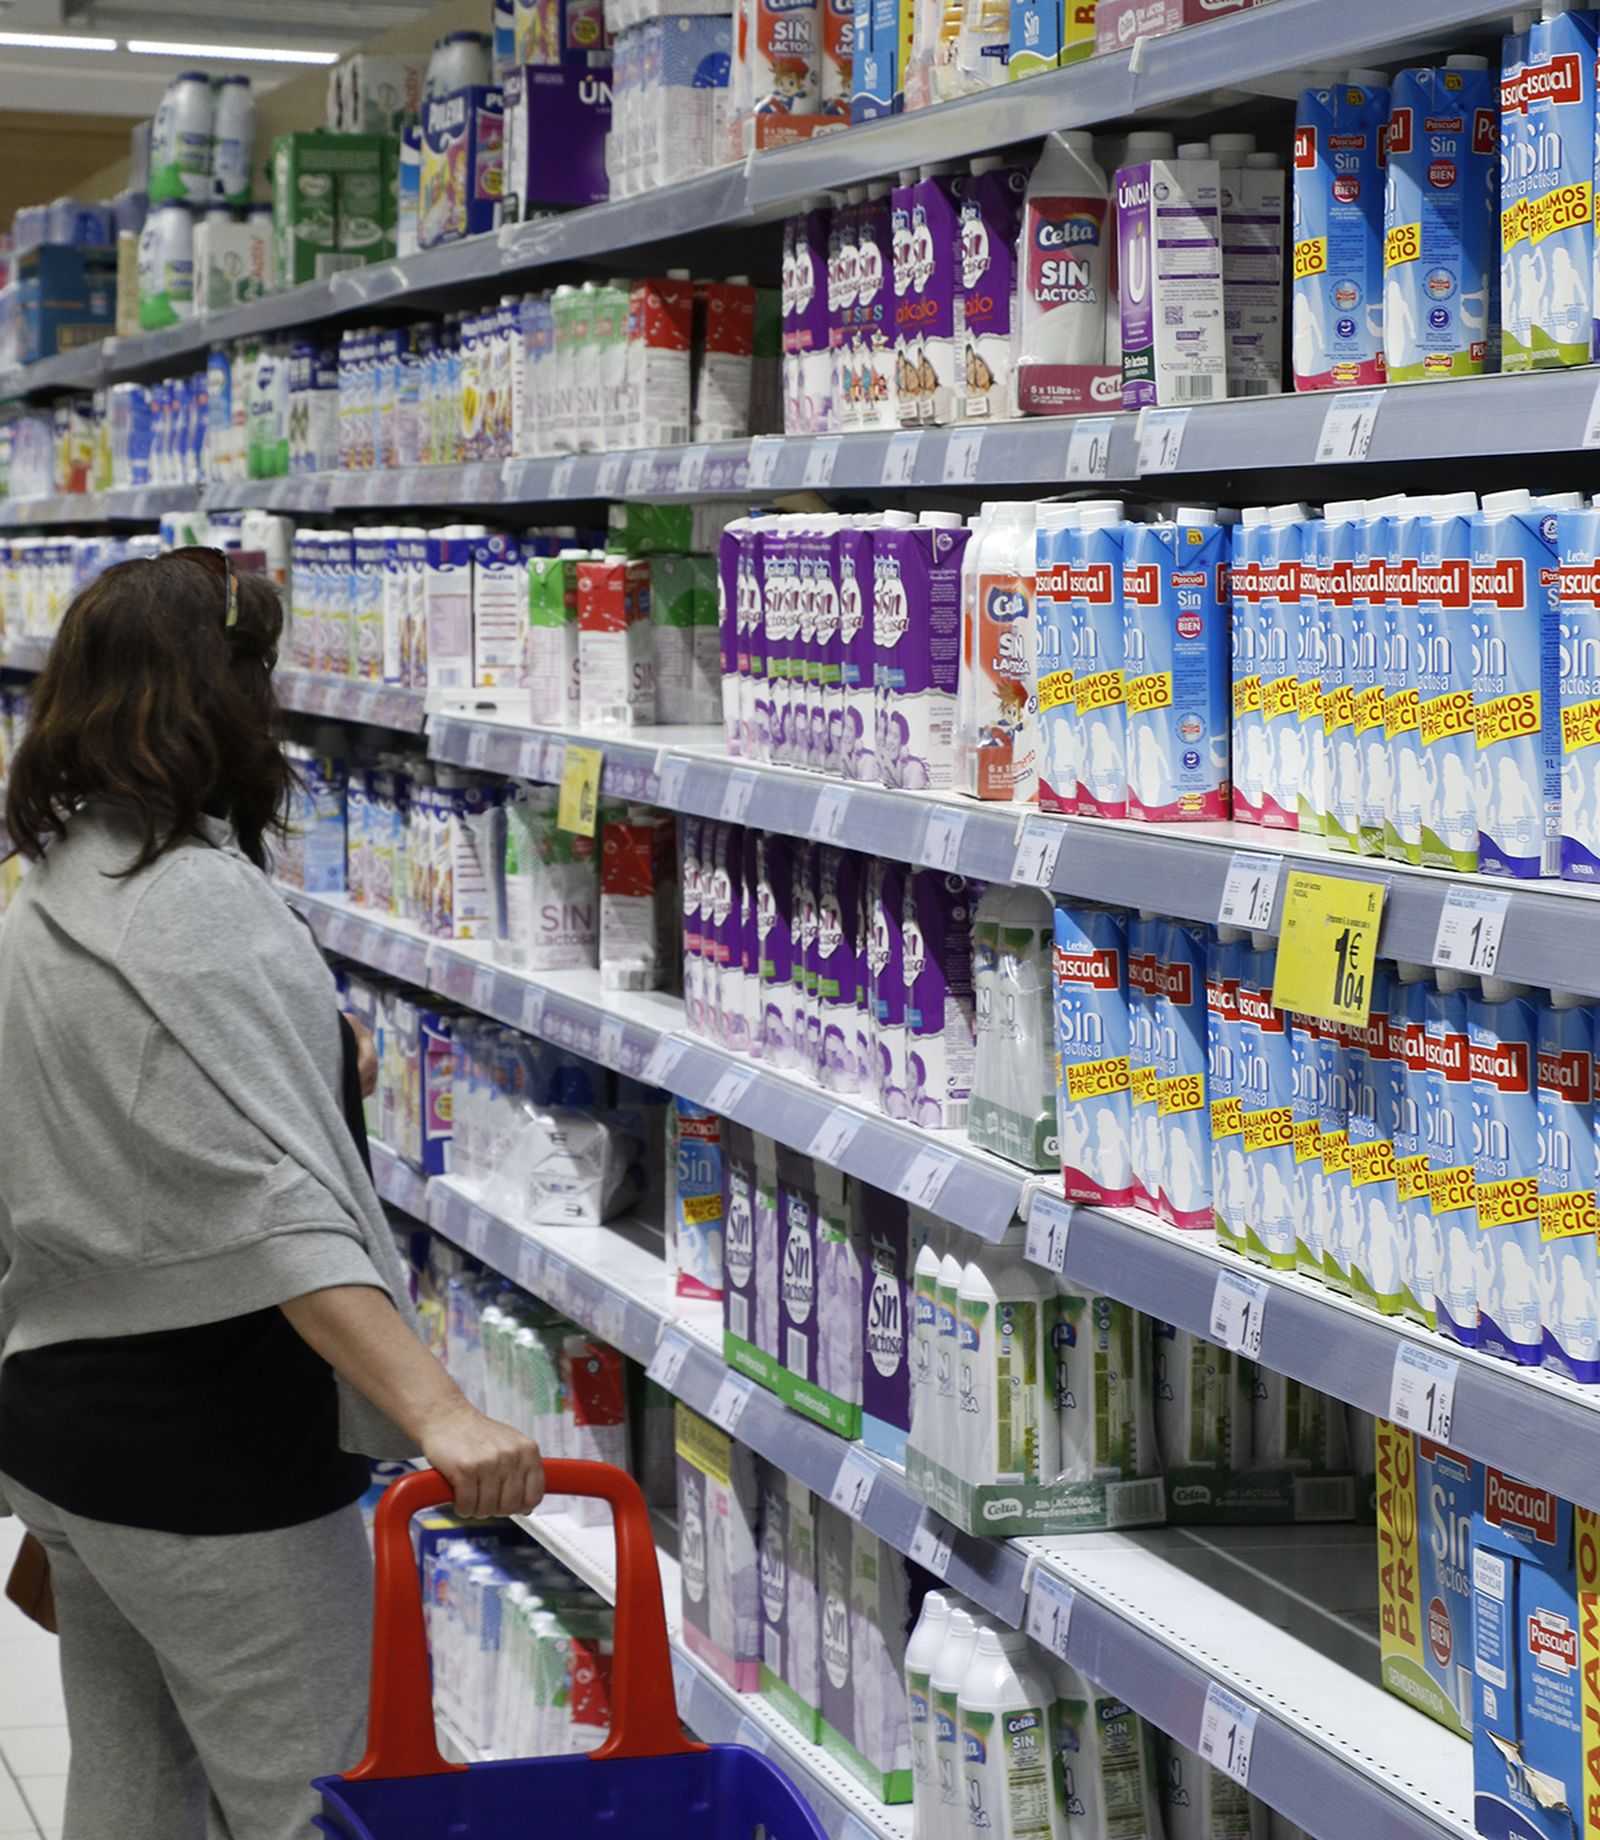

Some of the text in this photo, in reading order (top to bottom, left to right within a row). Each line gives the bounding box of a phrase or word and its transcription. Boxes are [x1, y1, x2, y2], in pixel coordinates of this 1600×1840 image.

[1430, 138, 1457, 154] Sin
[1334, 153, 1360, 169] Sin
[1429, 169, 1455, 180] BIEN
[1334, 185, 1359, 196] BIEN
[1530, 186, 1586, 220] BAJAMOS
[1039, 224, 1094, 246] Celta
[1040, 260, 1090, 286] SIN
[1034, 288, 1097, 303] LACTOSA
[1567, 550, 1590, 563] Leche
[1172, 574, 1204, 584] Pascual
[1177, 589, 1202, 606] Sin
[1177, 621, 1202, 632] BIEN
[1560, 678, 1600, 696] actosa
[1475, 694, 1535, 721] BAJAMOS
[1564, 703, 1600, 726] BAJAM
[541, 904, 593, 932] SIN
[1469, 917, 1496, 969] 1,15
[1059, 956, 1111, 978] ascual
[1059, 998, 1103, 1043] Sin
[1064, 1042, 1102, 1058] actosa
[1067, 1058, 1129, 1079] BAJAMOS
[1243, 1108, 1293, 1129] BAJAMOS
[1351, 1142, 1393, 1161] BAJAMO
[1474, 1155, 1508, 1178] actosa
[1477, 1179, 1539, 1201] BAJAMOS
[727, 1204, 750, 1245] Sin
[785, 1235, 810, 1281] Sin
[870, 1283, 898, 1331] Sin
[1425, 1382, 1450, 1438] 1,15
[1488, 1476, 1551, 1525] Pascual
[1393, 1424, 1416, 1647] PR€CI
[1431, 1484, 1472, 1571] Sin
[1436, 1557, 1471, 1597] lactos
[1430, 1626, 1451, 1650] BIEN
[1531, 1623, 1575, 1656] Pascual
[1007, 1717, 1037, 1732] Celta
[1011, 1736, 1035, 1749] SIN
[1227, 1723, 1248, 1777] 1,15
